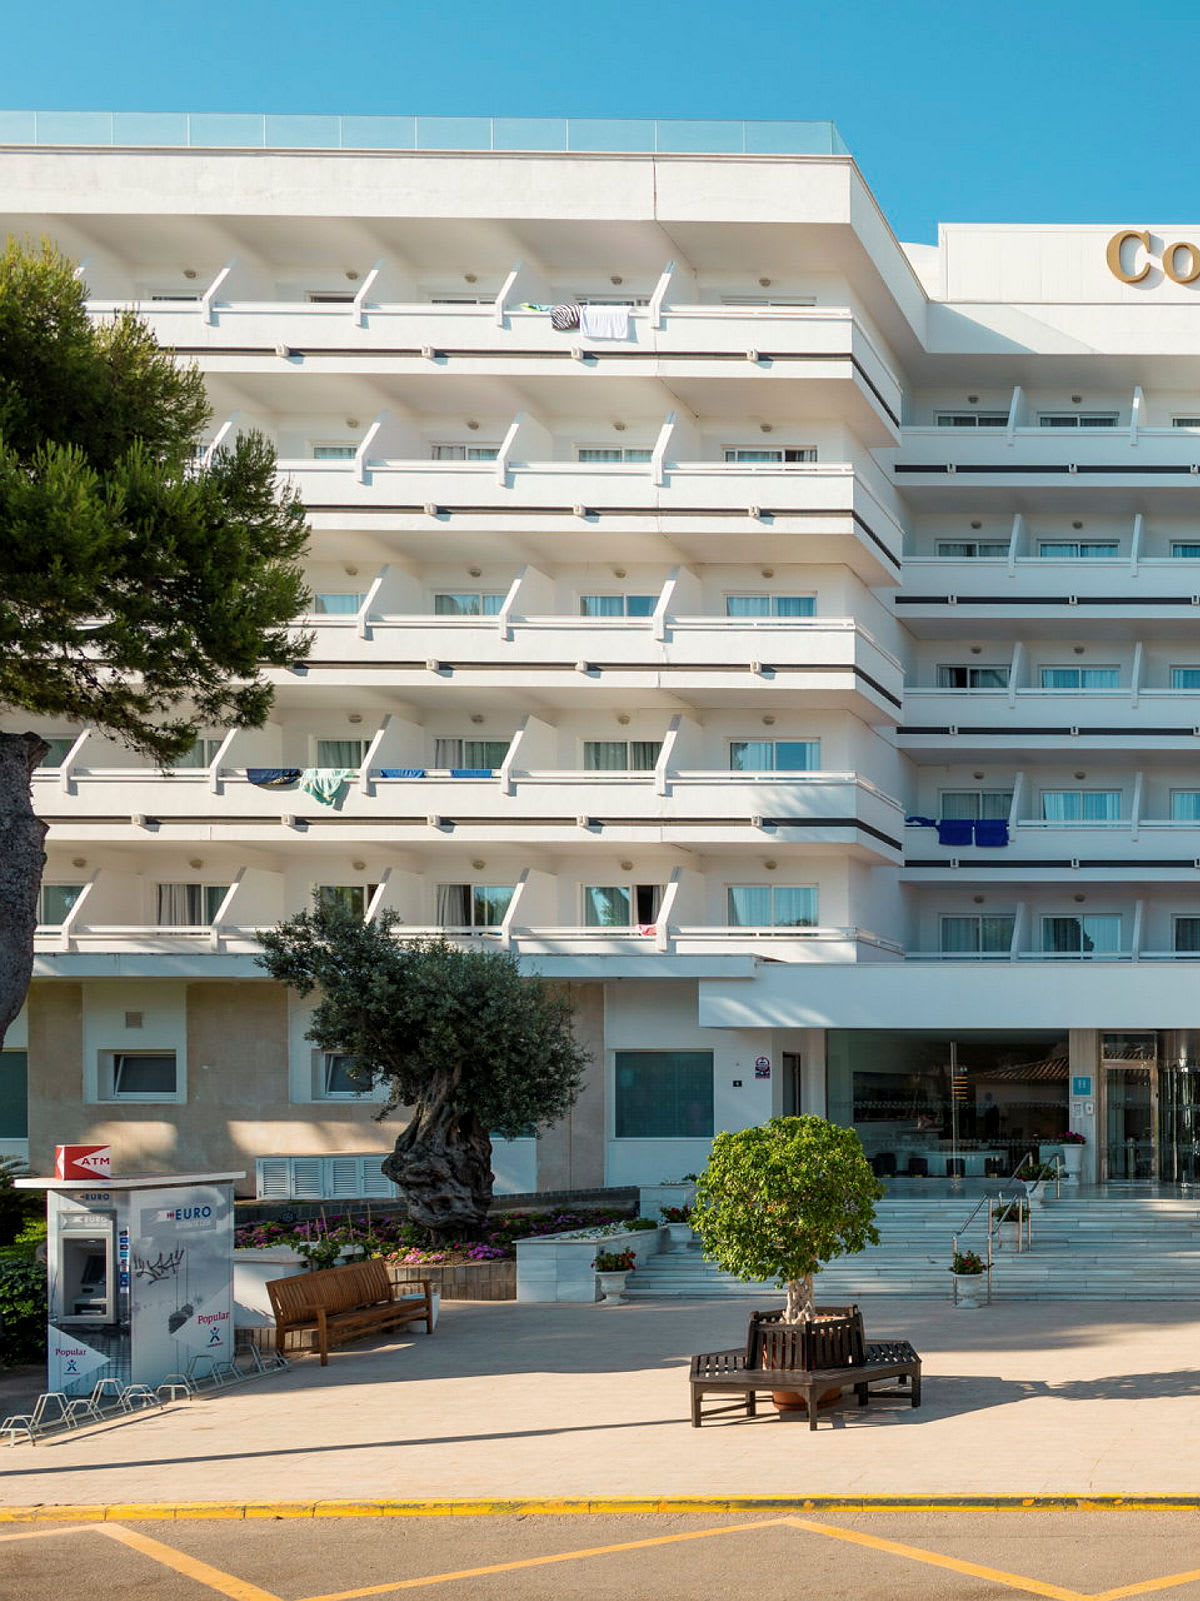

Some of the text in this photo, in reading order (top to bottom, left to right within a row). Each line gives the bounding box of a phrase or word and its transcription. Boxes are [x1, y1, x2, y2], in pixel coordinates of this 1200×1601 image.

[81, 1157, 110, 1165] ATM
[175, 1206, 212, 1220] EURO
[197, 1311, 230, 1325] Popular
[55, 1348, 87, 1357] Popular
